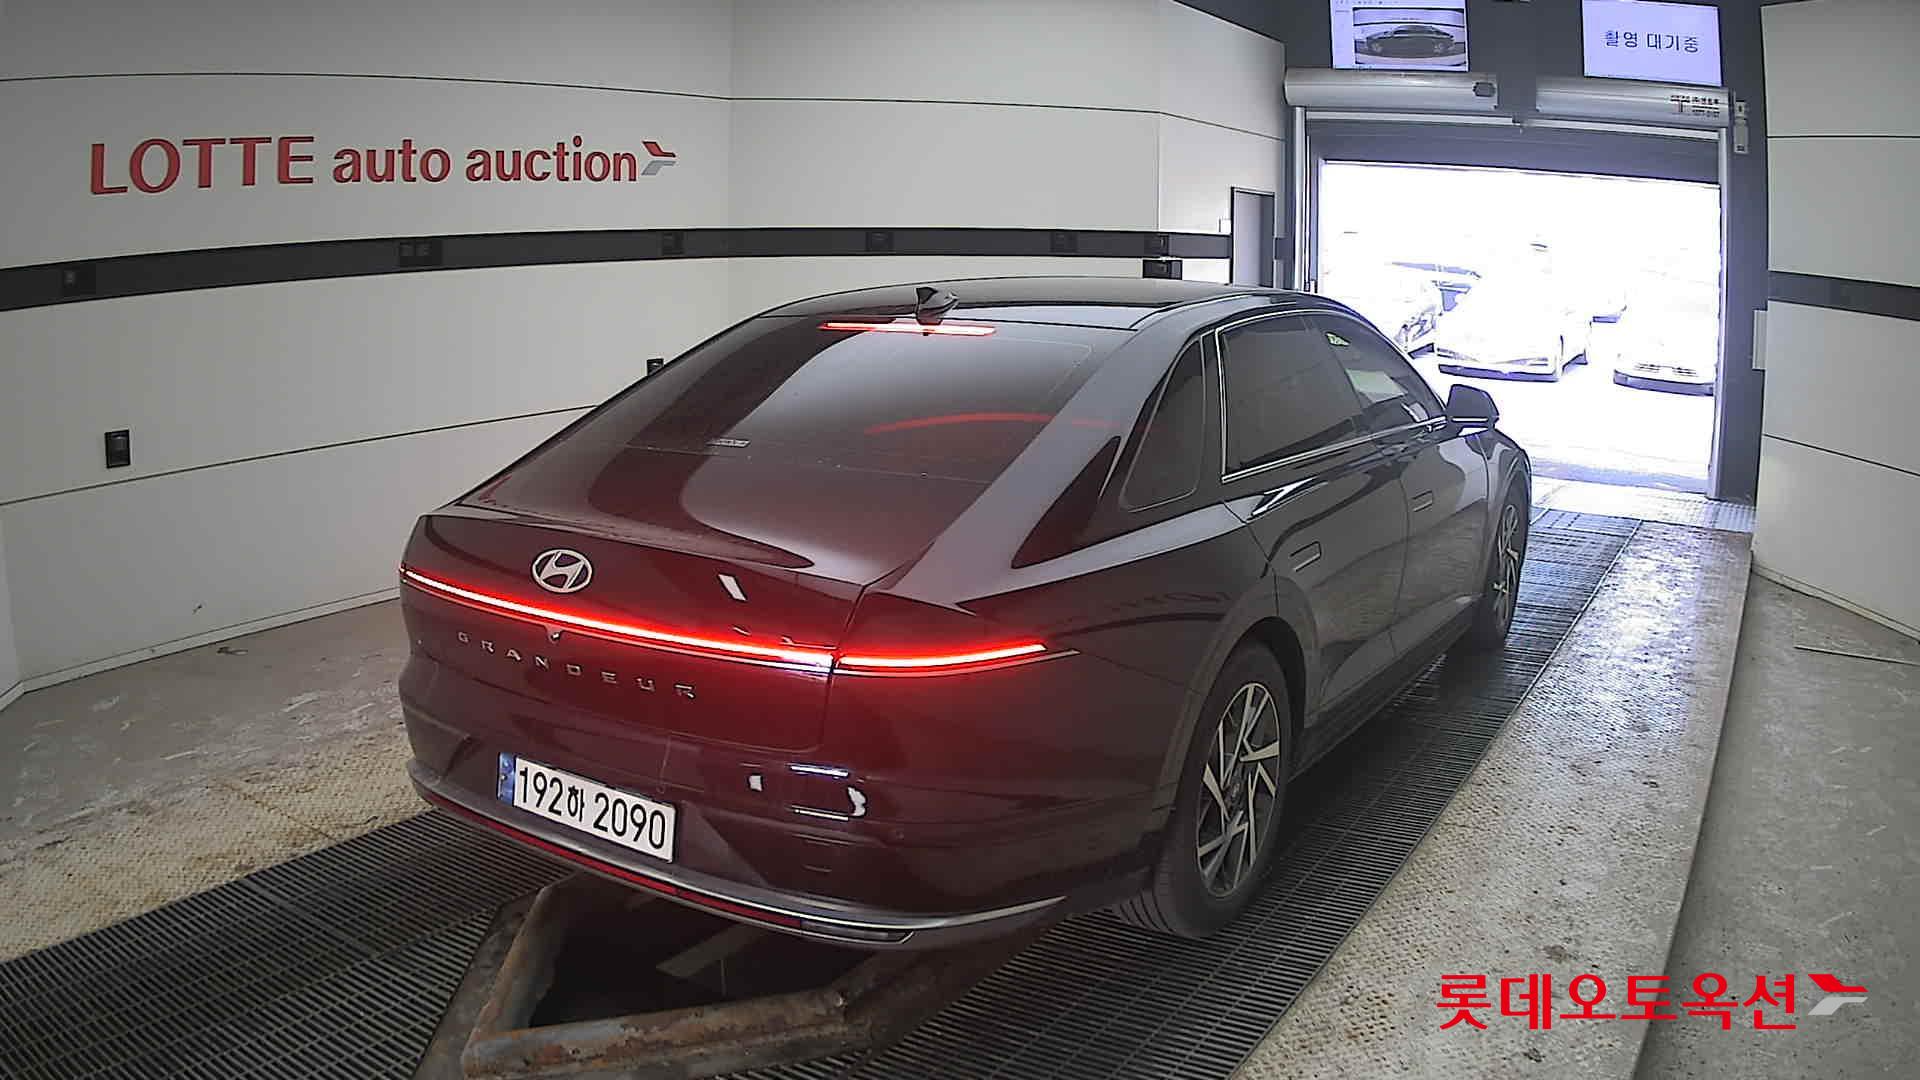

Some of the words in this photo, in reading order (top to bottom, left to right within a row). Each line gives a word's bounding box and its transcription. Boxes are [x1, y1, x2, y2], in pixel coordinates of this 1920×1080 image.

[1646, 33, 1698, 53] 대기중
[91, 136, 314, 195] LOTTE
[333, 139, 451, 183] auto
[465, 135, 638, 182] auction
[457, 631, 696, 699] GRANDEUR
[519, 767, 585, 822] 192하
[593, 792, 666, 850] 2090
